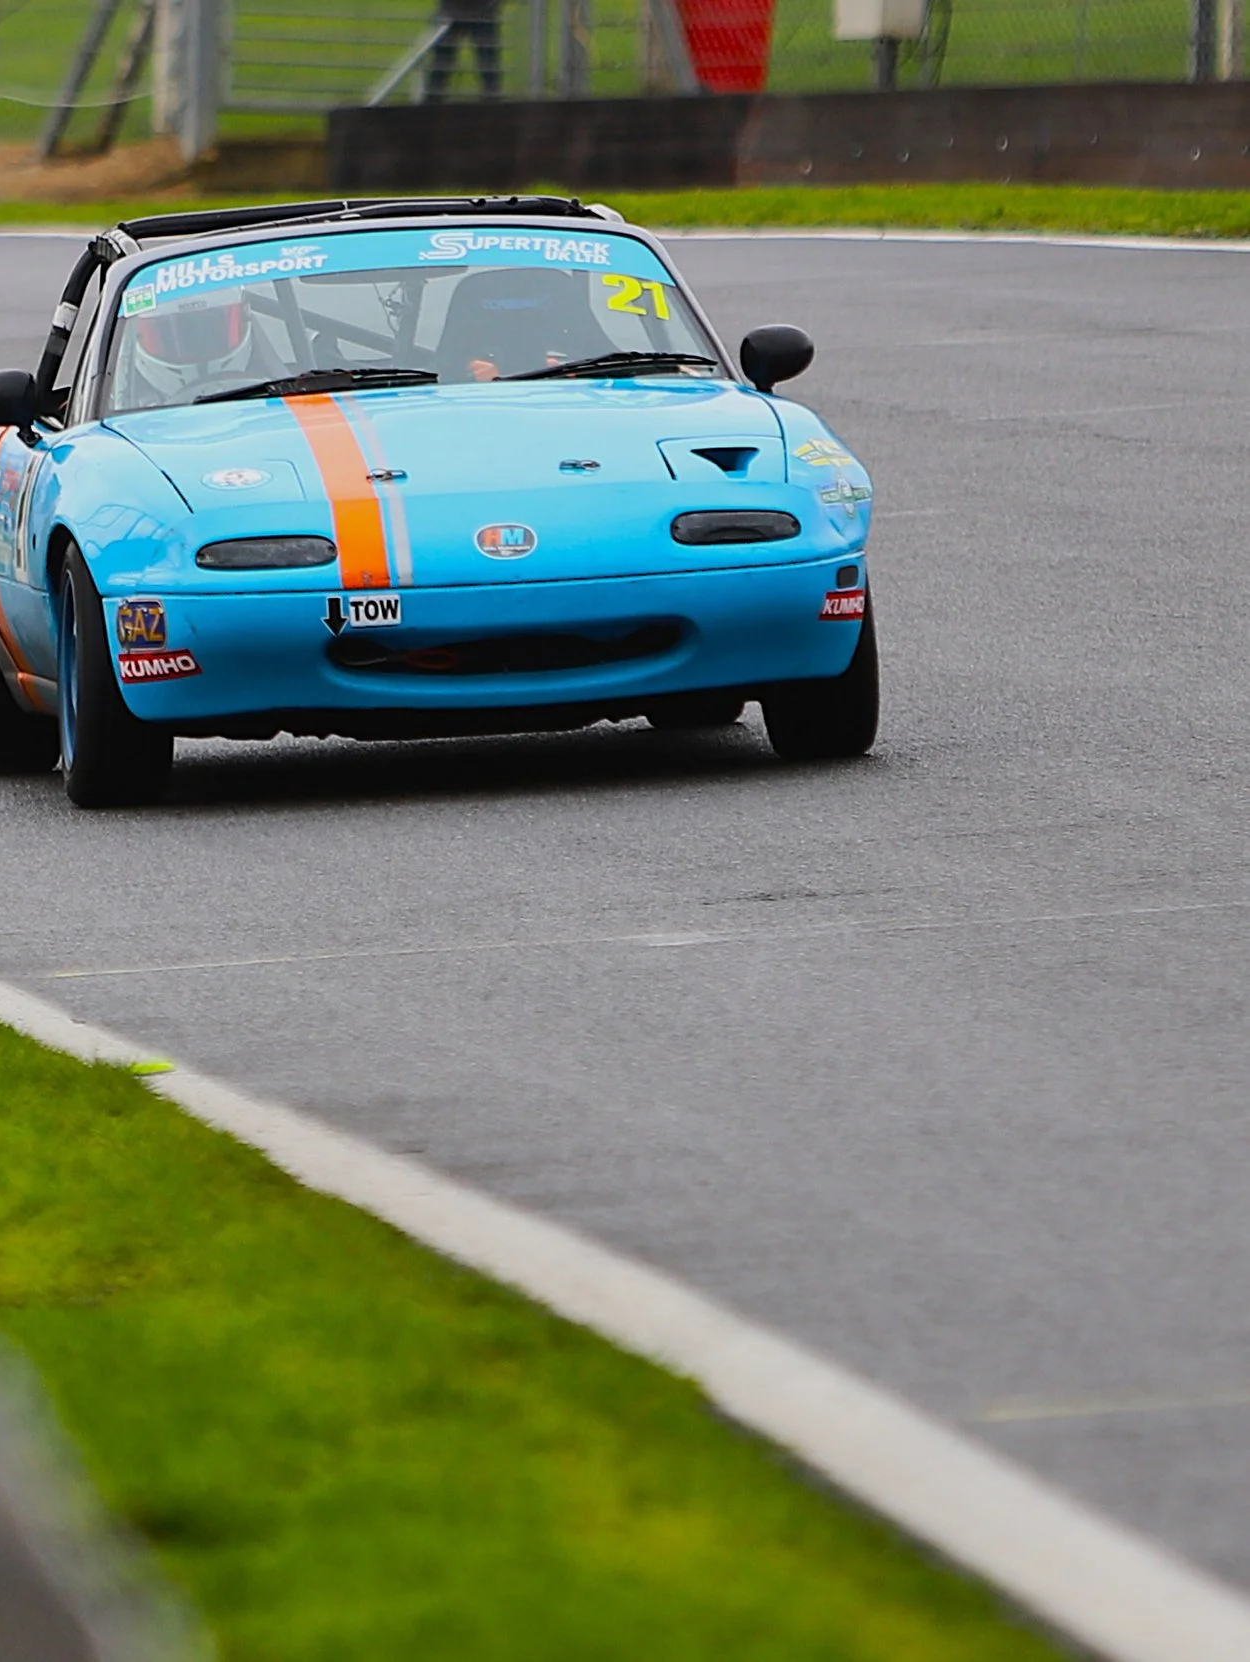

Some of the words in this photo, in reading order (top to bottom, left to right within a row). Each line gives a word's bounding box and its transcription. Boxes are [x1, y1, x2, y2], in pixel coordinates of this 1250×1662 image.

[419, 232, 610, 260] SUPERTRACK
[545, 250, 571, 261] UK
[155, 255, 328, 294] MOTORSPORT
[156, 254, 235, 279] HILLS
[601, 274, 670, 321] 21
[482, 527, 525, 546] HM
[350, 599, 399, 622] TOW
[119, 655, 197, 678] KUMHO
